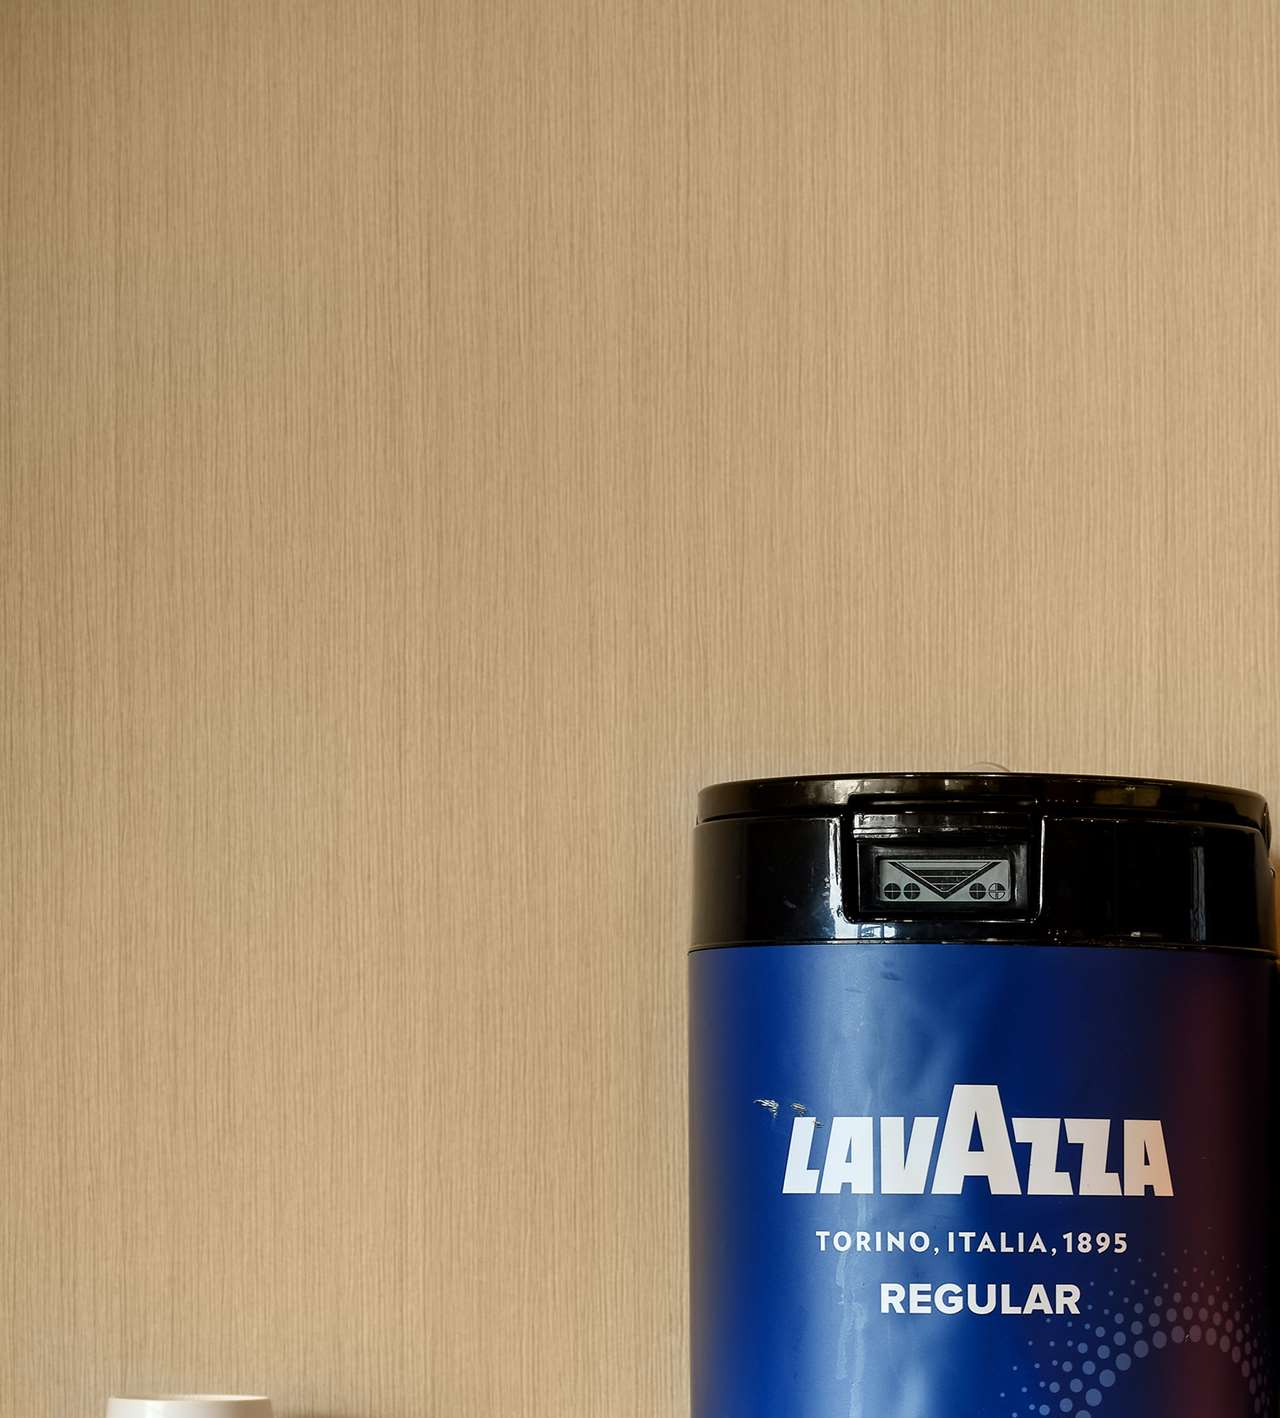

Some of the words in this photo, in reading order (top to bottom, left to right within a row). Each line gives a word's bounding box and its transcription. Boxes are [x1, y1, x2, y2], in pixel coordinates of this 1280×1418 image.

[782, 1084, 1174, 1196] LAVAZZA
[1063, 1232, 1128, 1254] 1895
[880, 1284, 1081, 1315] REGULAR
